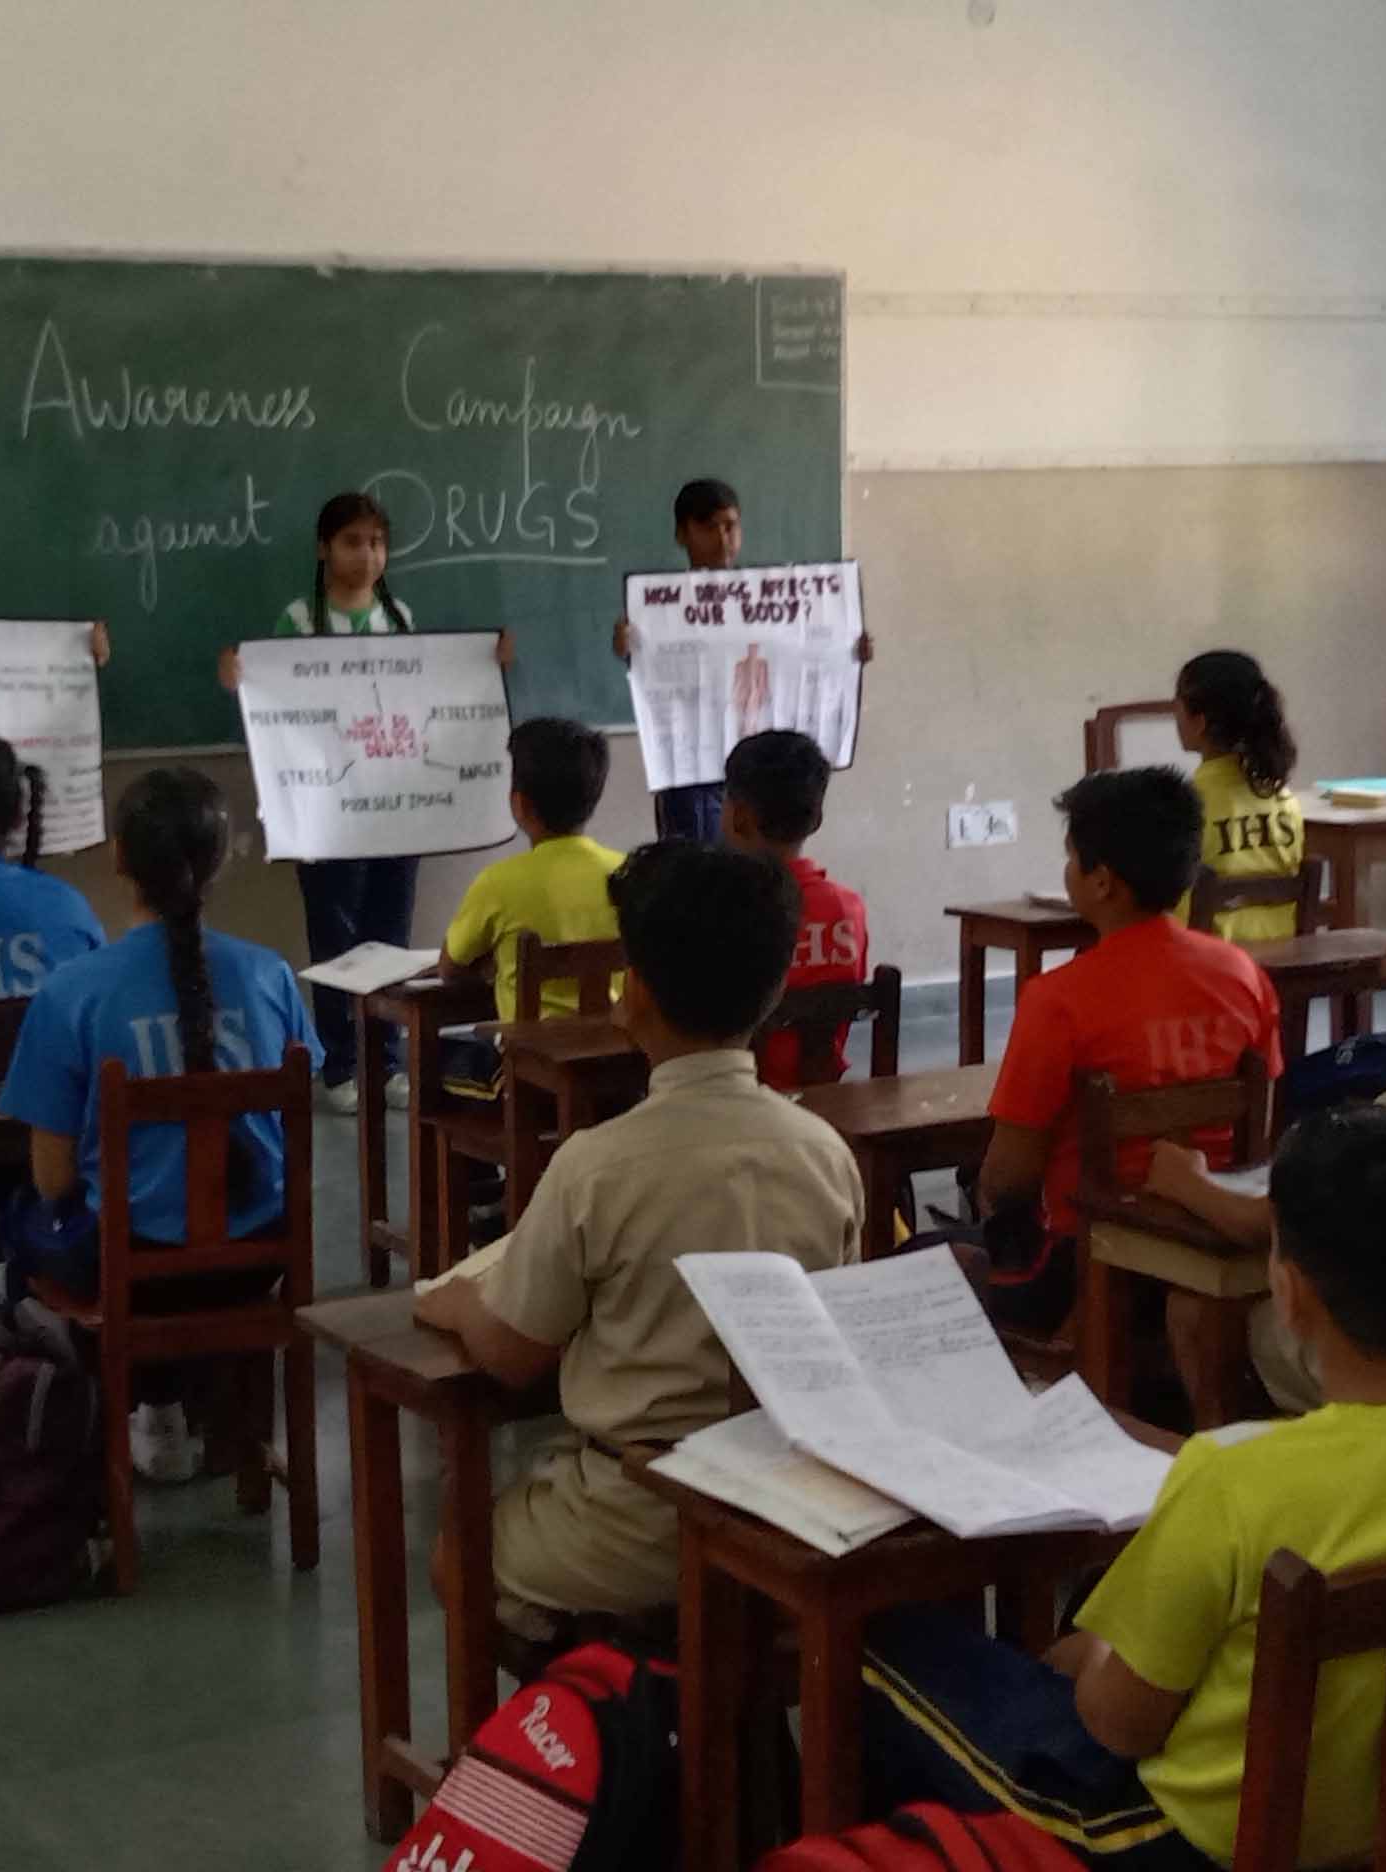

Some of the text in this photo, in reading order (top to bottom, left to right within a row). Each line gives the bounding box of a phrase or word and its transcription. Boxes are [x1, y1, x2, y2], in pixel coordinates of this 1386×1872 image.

[400, 324, 642, 497] Campaign
[91, 469, 601, 613] against DRUGS
[694, 581, 752, 603] DRUGS
[684, 604, 725, 625] OUR
[293, 657, 422, 678] OVER AMBITIOUS
[277, 769, 332, 788] STRESS
[1212, 810, 1296, 856] IHS
[518, 1694, 576, 1772] Racer
